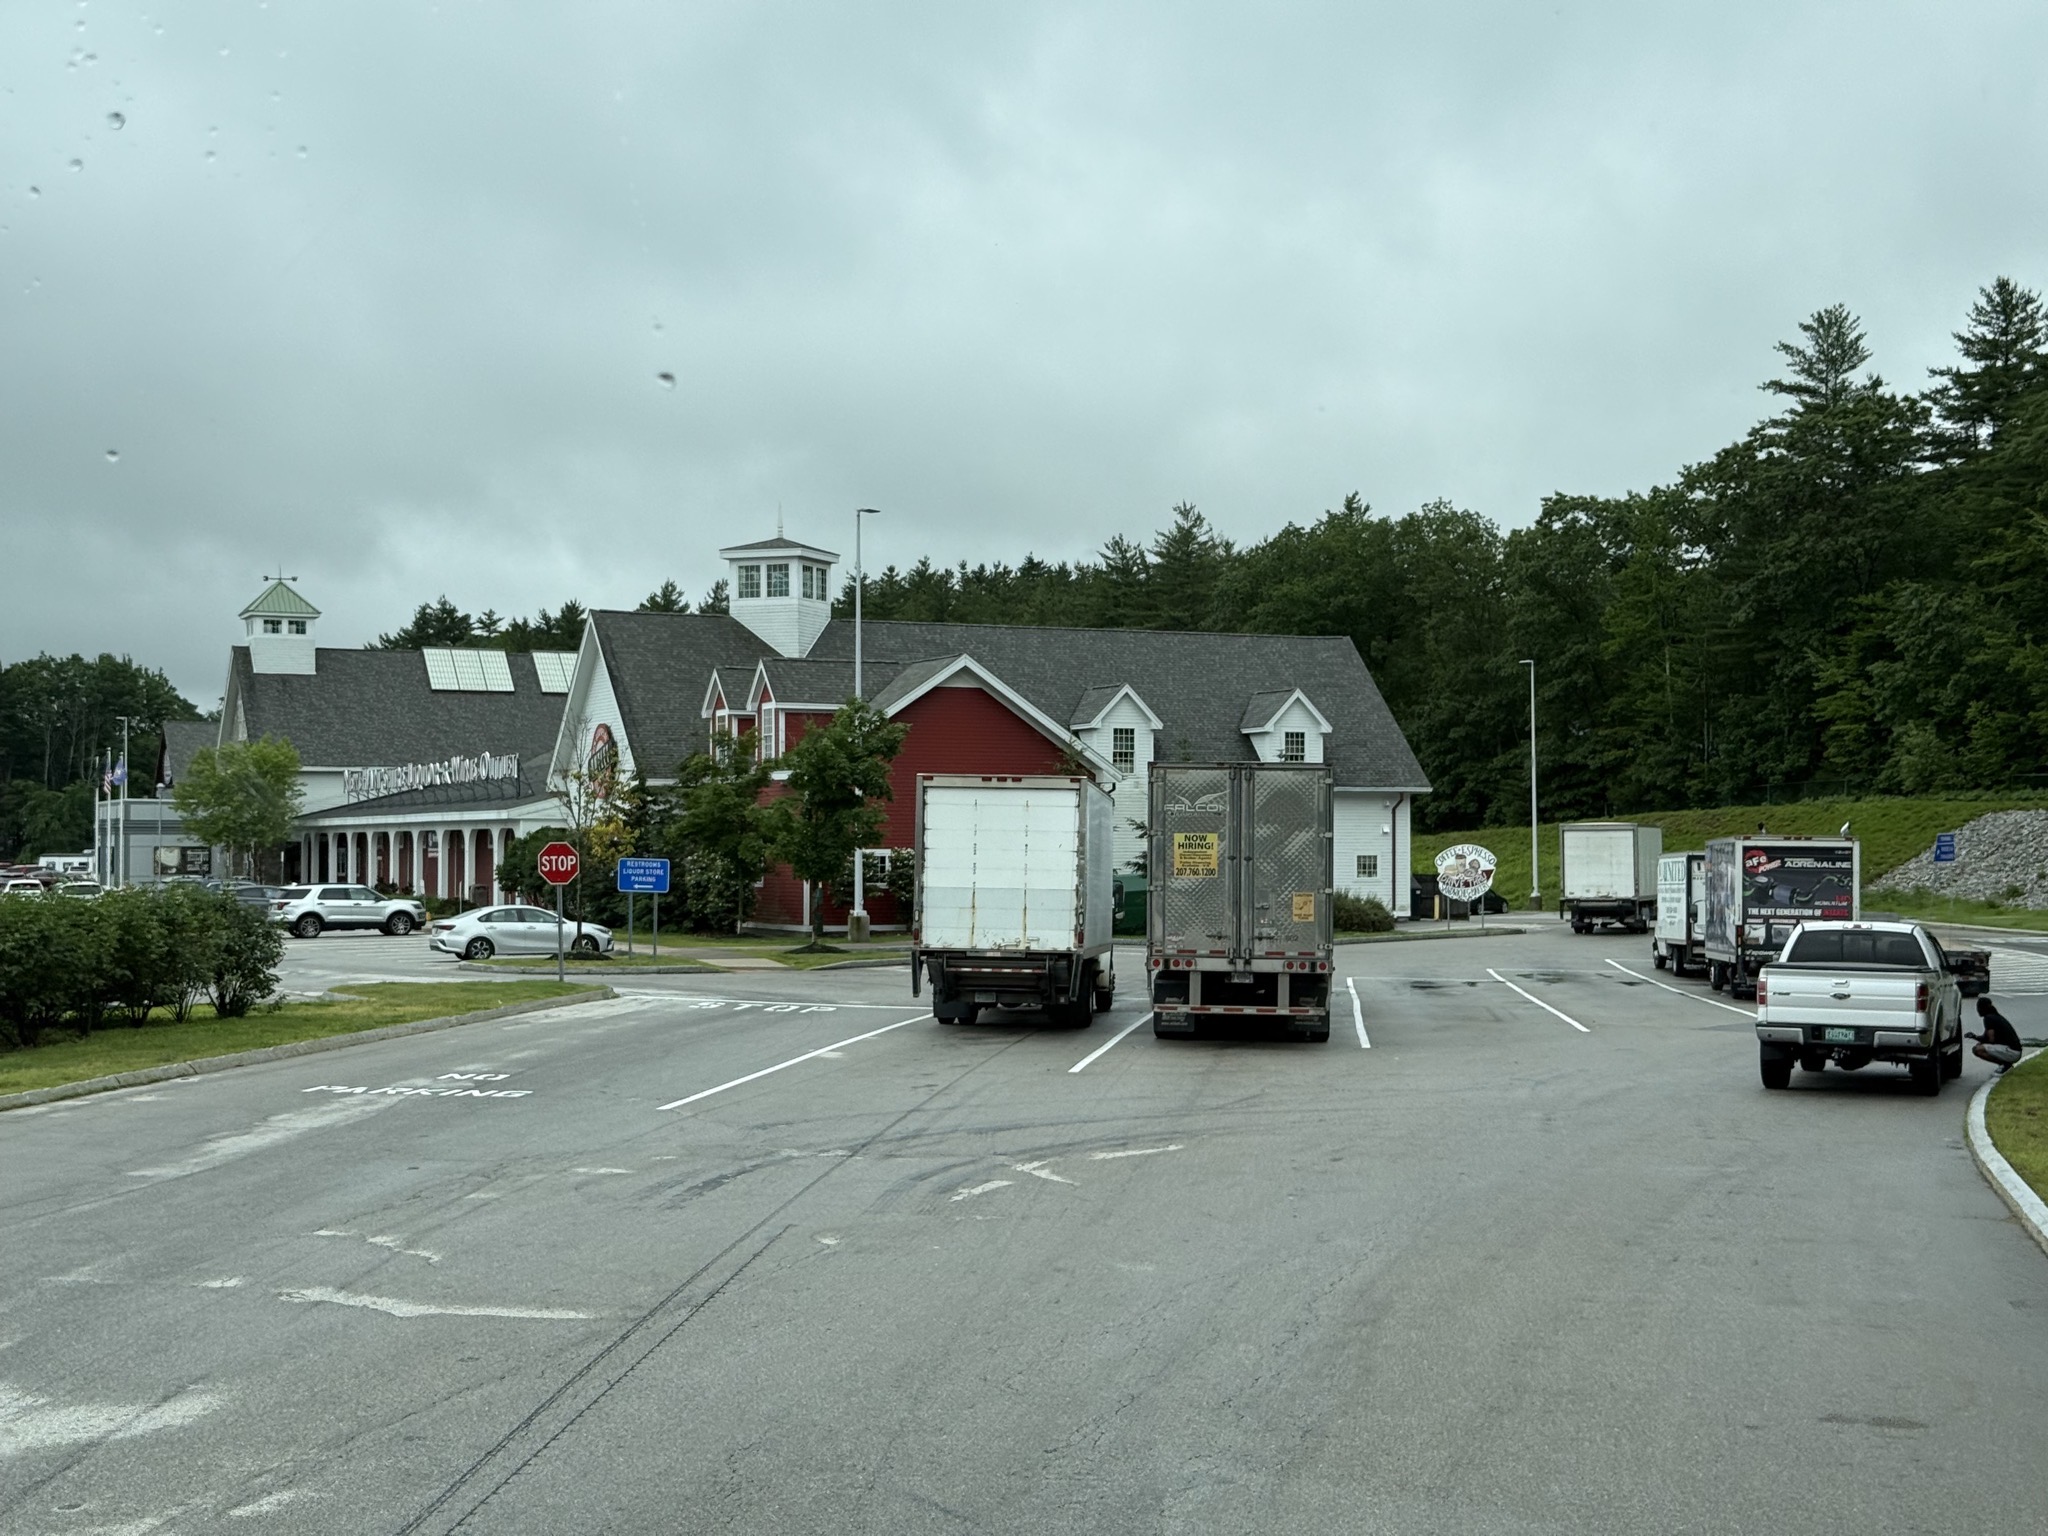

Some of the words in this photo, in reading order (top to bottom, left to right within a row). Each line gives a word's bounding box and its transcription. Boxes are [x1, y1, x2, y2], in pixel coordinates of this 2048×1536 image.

[1163, 803, 1229, 811] FALCON
[1184, 834, 1207, 842] NOW
[1177, 842, 1214, 850] HIRING!
[1436, 848, 1458, 866] COFFEE
[1462, 846, 1495, 864] ESPRESSO
[541, 855, 577, 871] STOP
[1175, 868, 1216, 876] 207.760.1200
[688, 1001, 838, 1013] STOP
[436, 1073, 511, 1081] NO
[302, 1085, 534, 1097] PARKING
